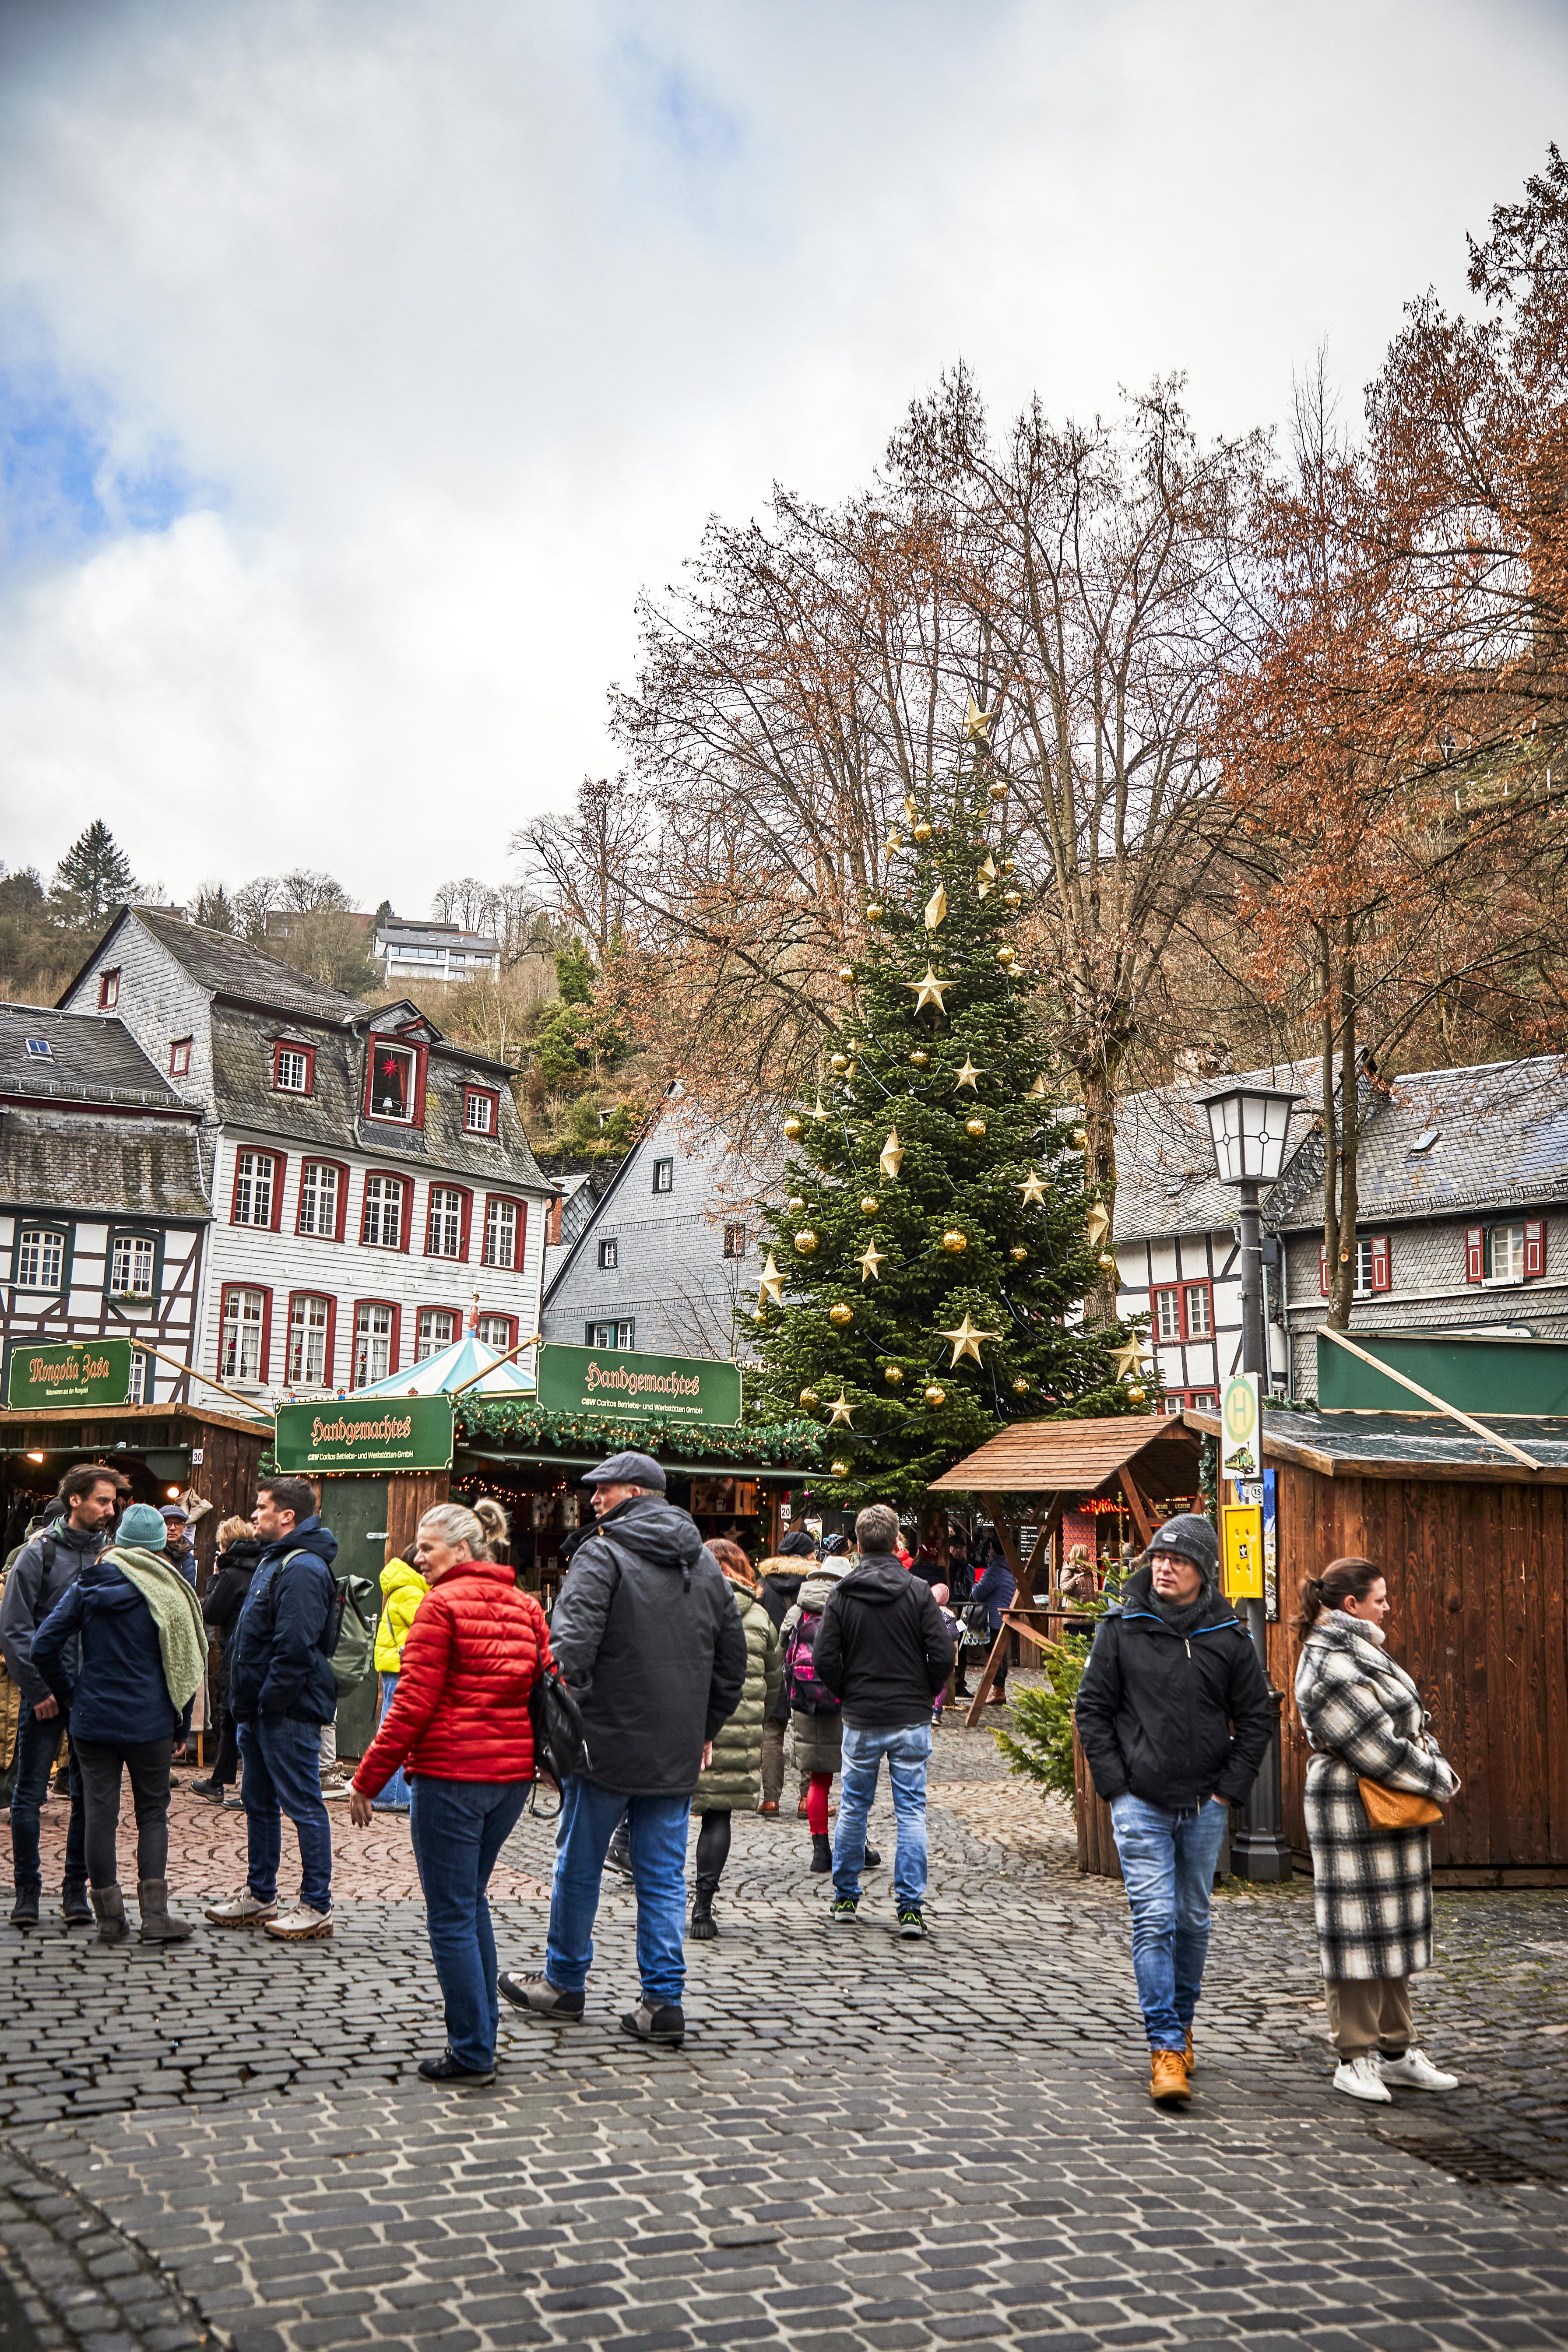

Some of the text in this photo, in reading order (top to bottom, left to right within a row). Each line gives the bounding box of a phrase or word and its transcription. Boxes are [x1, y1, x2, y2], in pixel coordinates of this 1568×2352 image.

[29, 1356, 79, 1386] Mongolia
[585, 1362, 700, 1399] Handgemachtes
[74, 1386, 89, 1395] Mongolei
[597, 1399, 617, 1407] Caritas
[617, 1401, 642, 1409] Betriebs-
[654, 1404, 685, 1413] Werkstätten
[1233, 1392, 1246, 1428] H
[311, 1414, 411, 1446] Handgemachtes
[194, 1453, 202, 1461] 30
